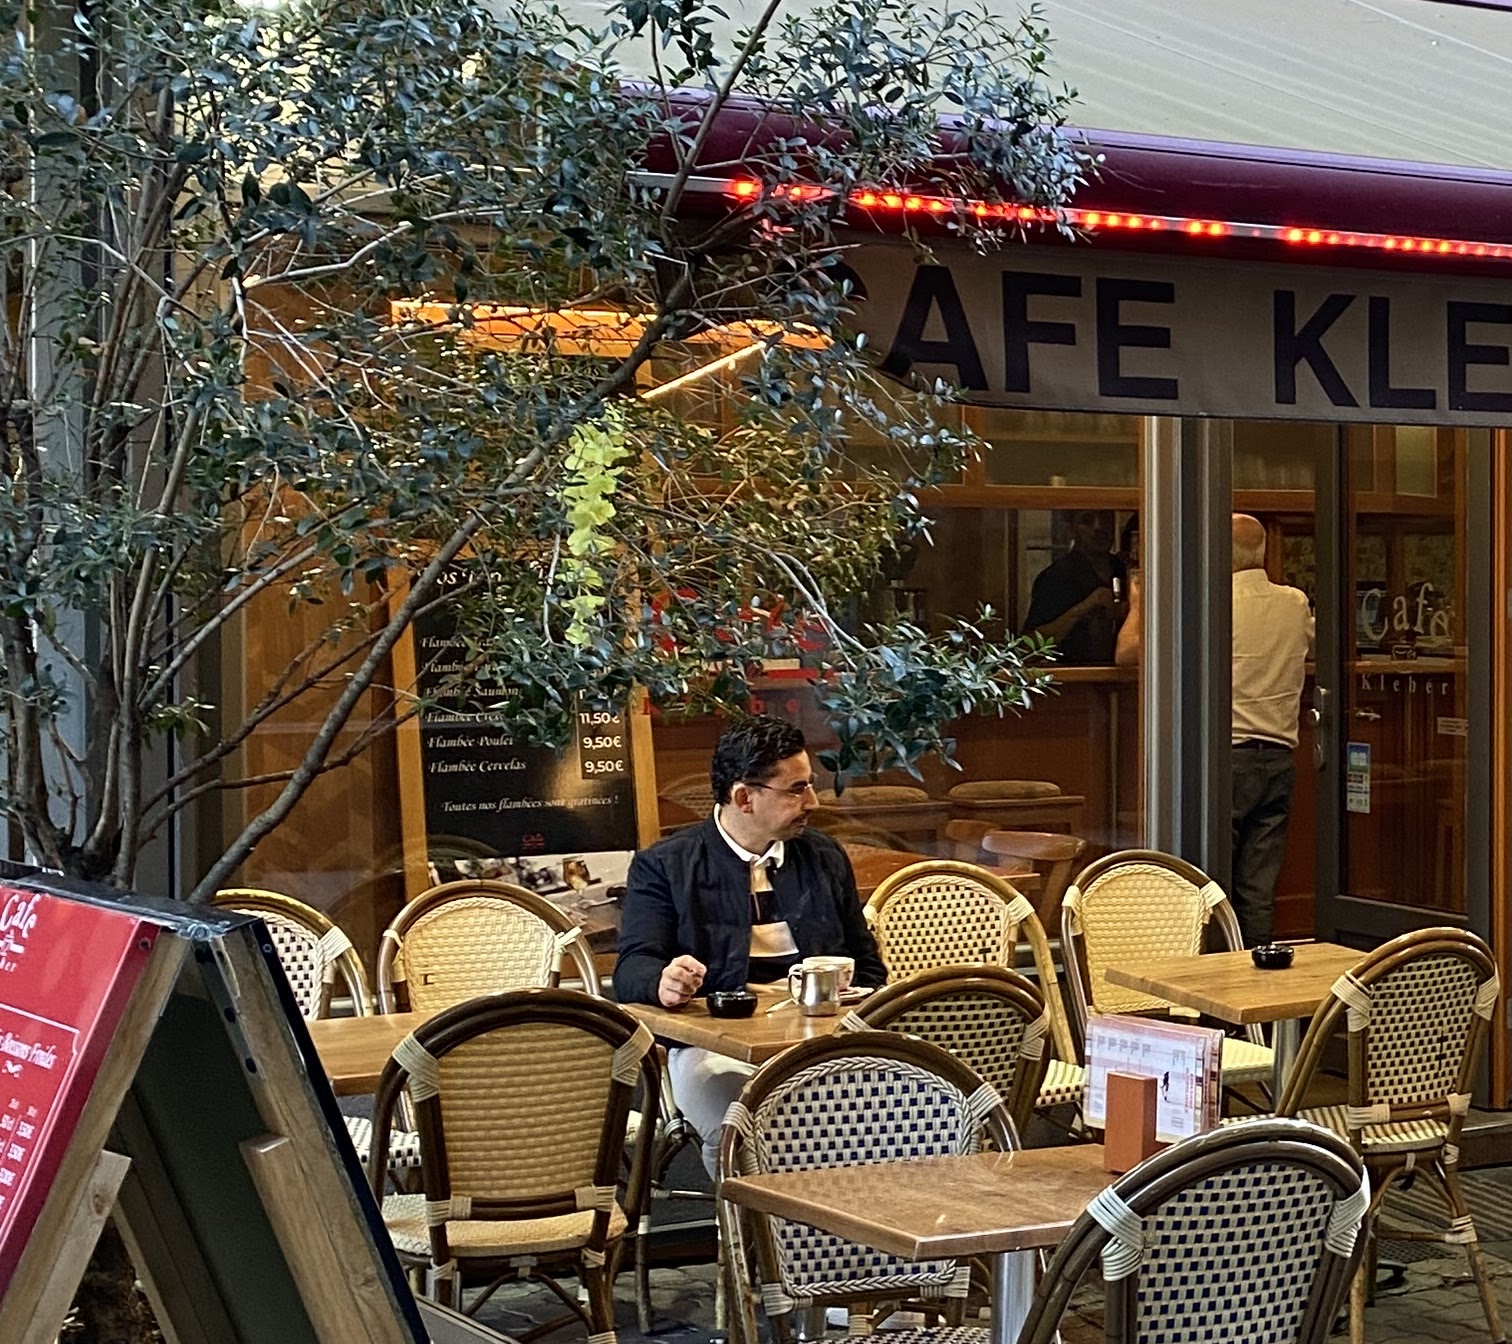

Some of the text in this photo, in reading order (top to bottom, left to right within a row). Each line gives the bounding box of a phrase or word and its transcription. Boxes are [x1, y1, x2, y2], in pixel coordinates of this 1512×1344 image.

[1361, 674, 1449, 695] Kleber
[428, 734, 513, 748] Flambée Poulet
[582, 736, 622, 750] 9,50€
[429, 757, 527, 773] Flambée Cervelas
[584, 760, 624, 774] 9,50€
[441, 801, 477, 812] Toutes
[478, 803, 497, 811] nos
[496, 797, 542, 813] flambées
